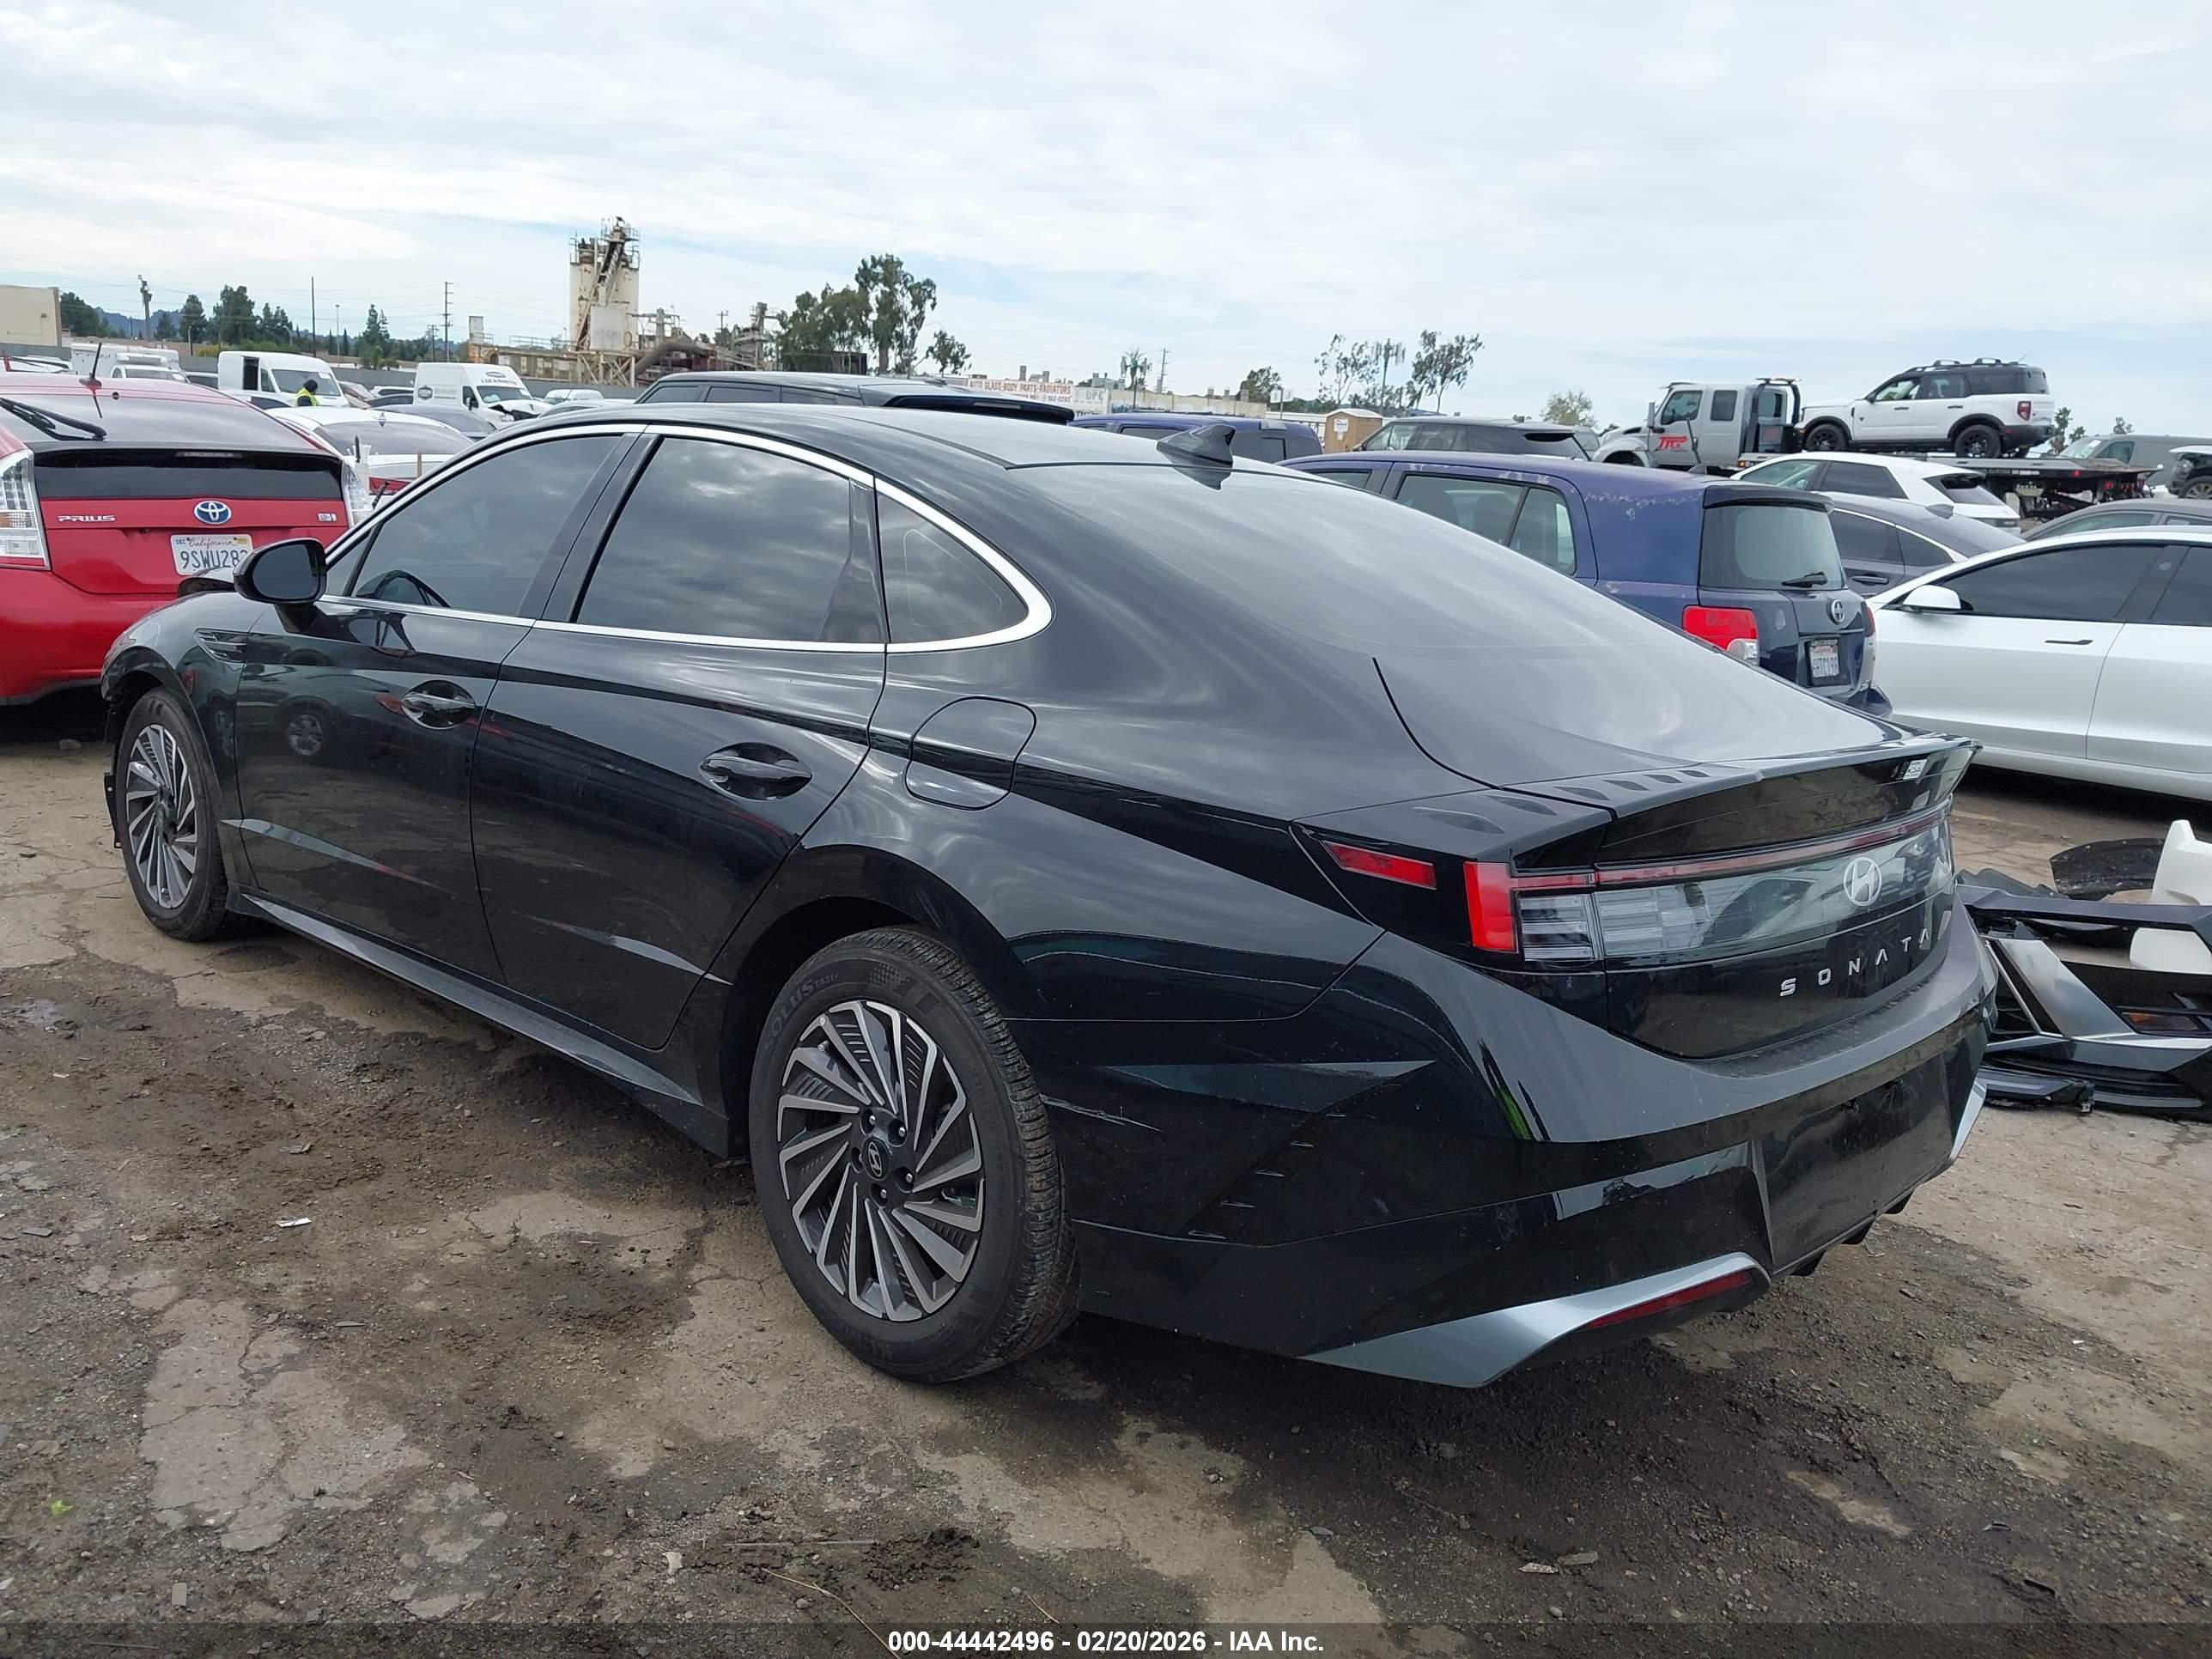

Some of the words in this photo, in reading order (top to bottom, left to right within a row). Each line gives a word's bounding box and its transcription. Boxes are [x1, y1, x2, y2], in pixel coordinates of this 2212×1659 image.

[188, 536, 232, 549] California
[1780, 928, 1929, 997] SONATA
[764, 979, 814, 1051] SOLUS
